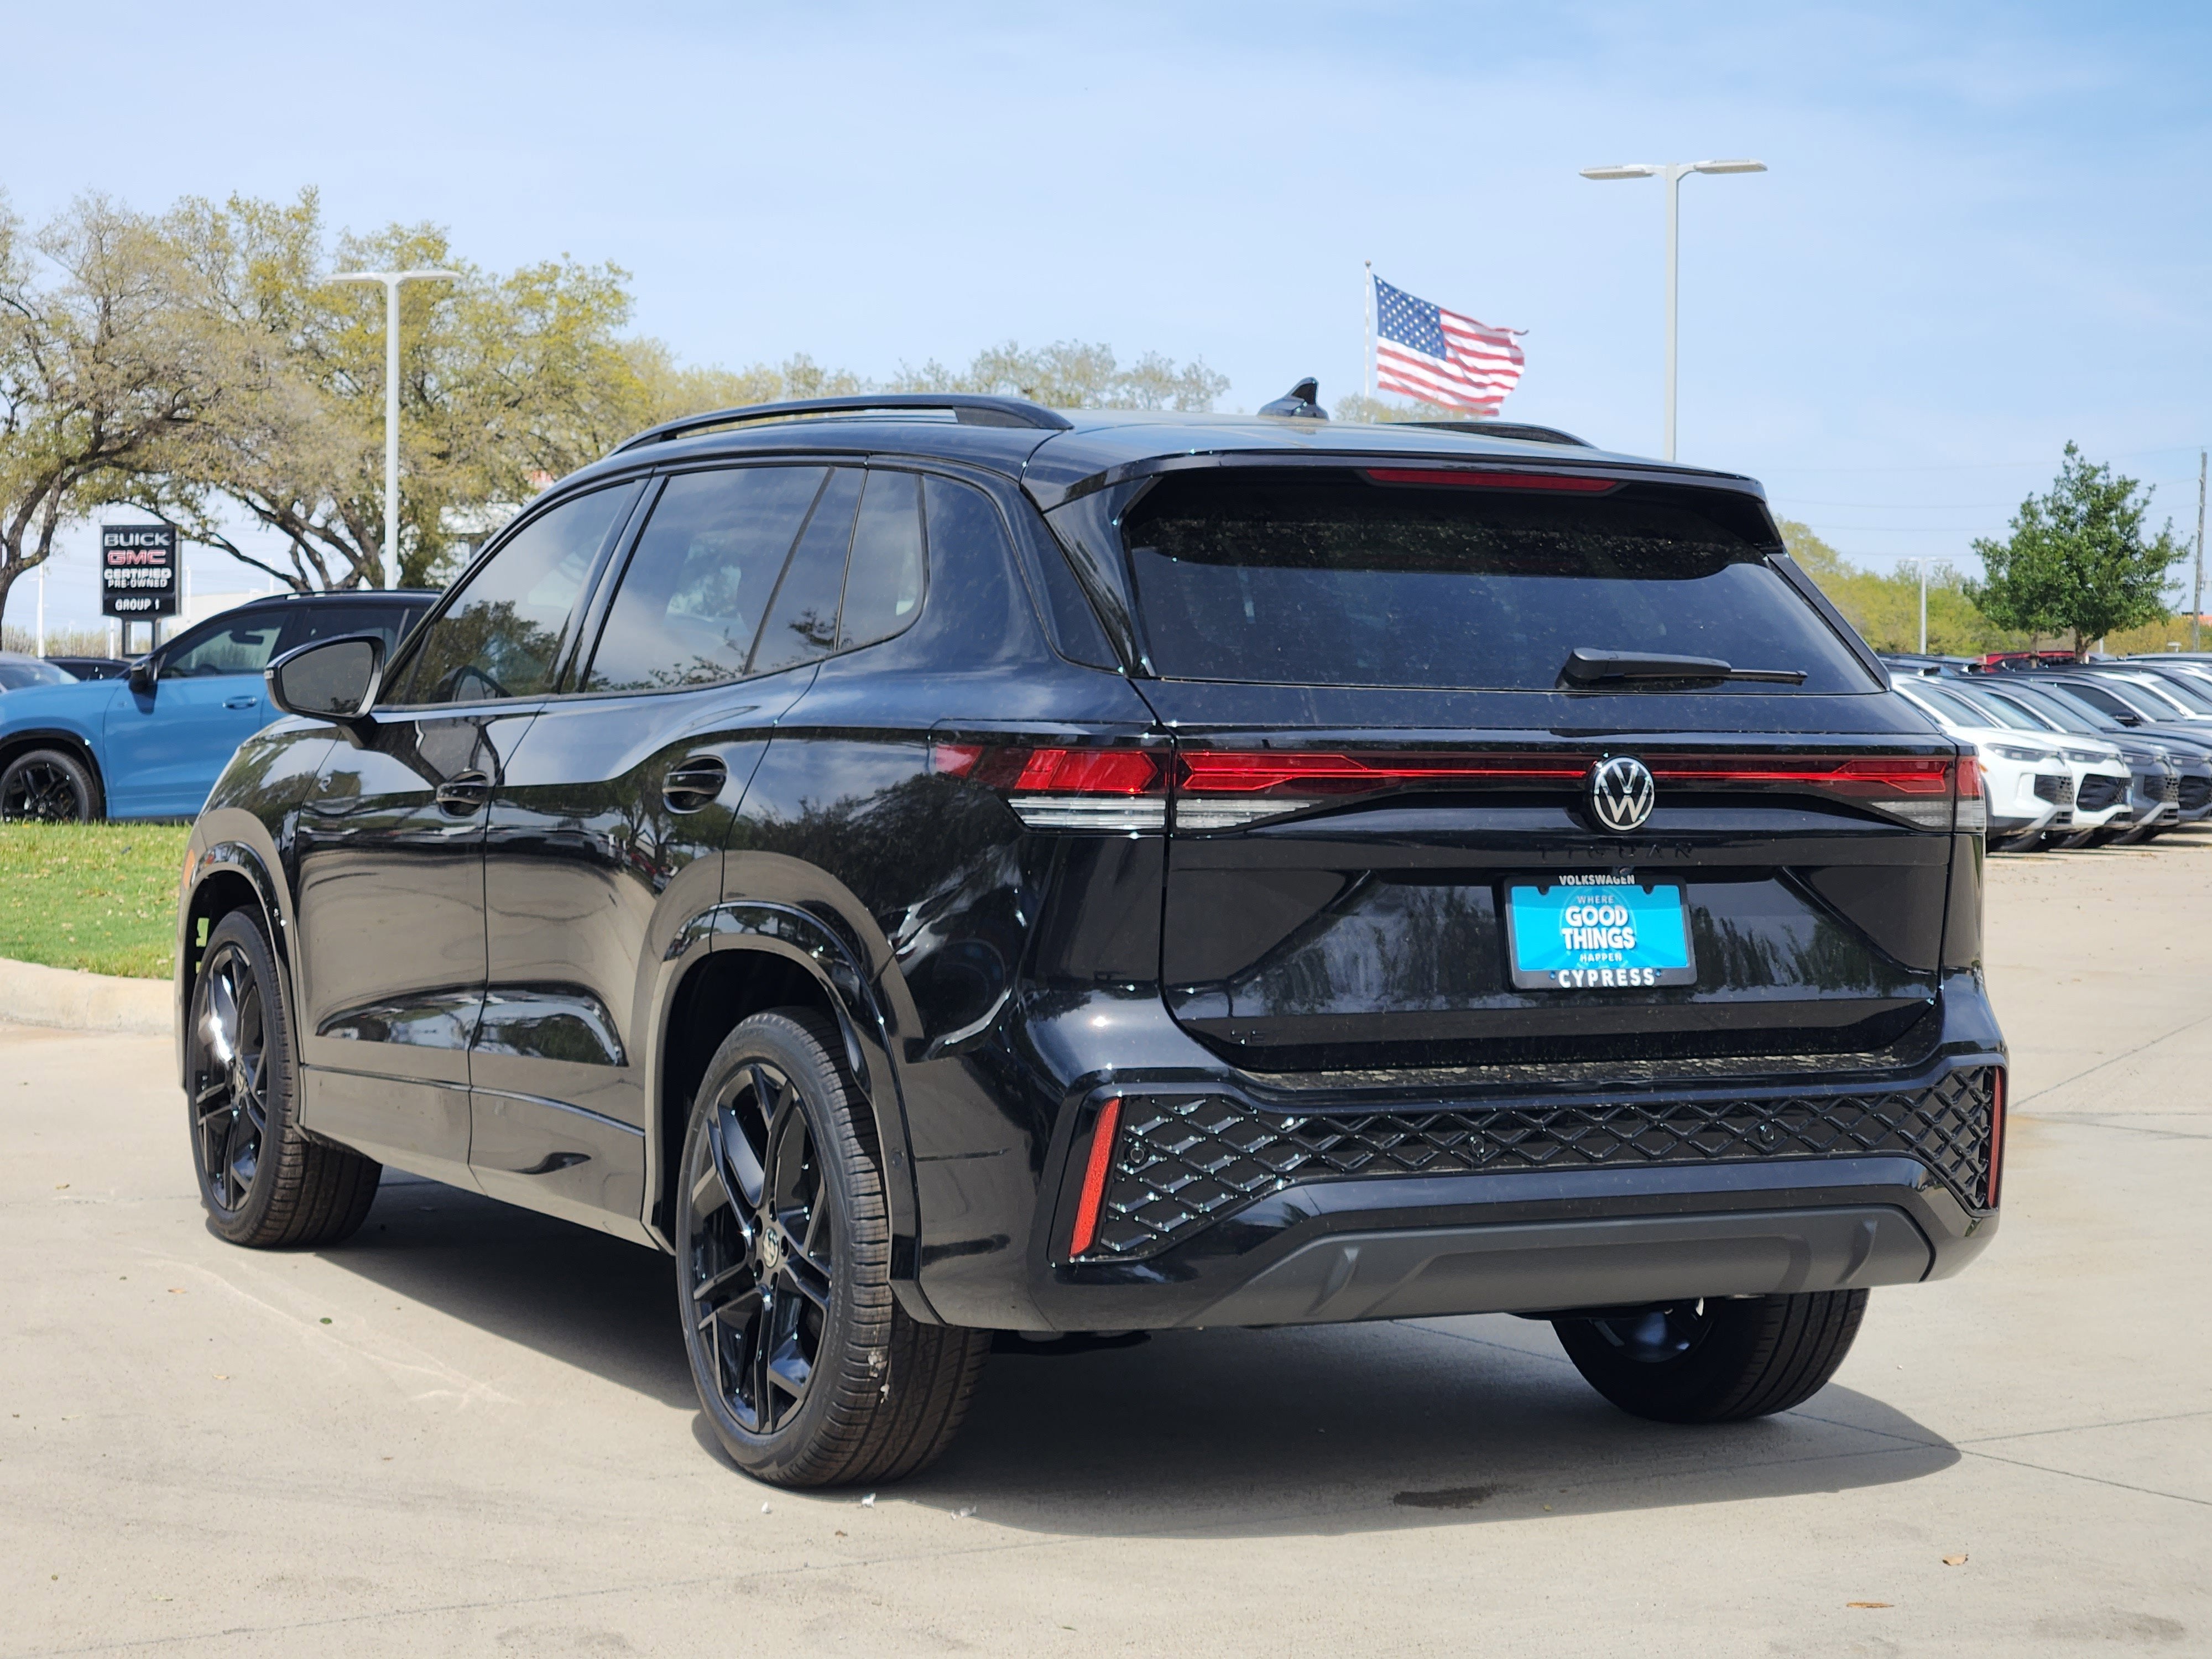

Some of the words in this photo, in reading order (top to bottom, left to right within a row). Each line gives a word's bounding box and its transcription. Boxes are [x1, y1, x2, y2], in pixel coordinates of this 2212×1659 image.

[104, 533, 170, 547] BUICK
[107, 550, 166, 565] GMC
[104, 567, 172, 580] CERTIFIED
[108, 579, 168, 588] PRE-OWNED
[115, 598, 152, 611] GROUP
[155, 598, 160, 611] 1
[1558, 874, 1635, 885] VOLKSWAGEN
[1577, 895, 1615, 905] WHERE
[1565, 905, 1629, 927] GOOD
[1561, 927, 1636, 950] THINGS
[1579, 952, 1623, 963] HAPPEN
[1558, 967, 1655, 988] CYPRESS
